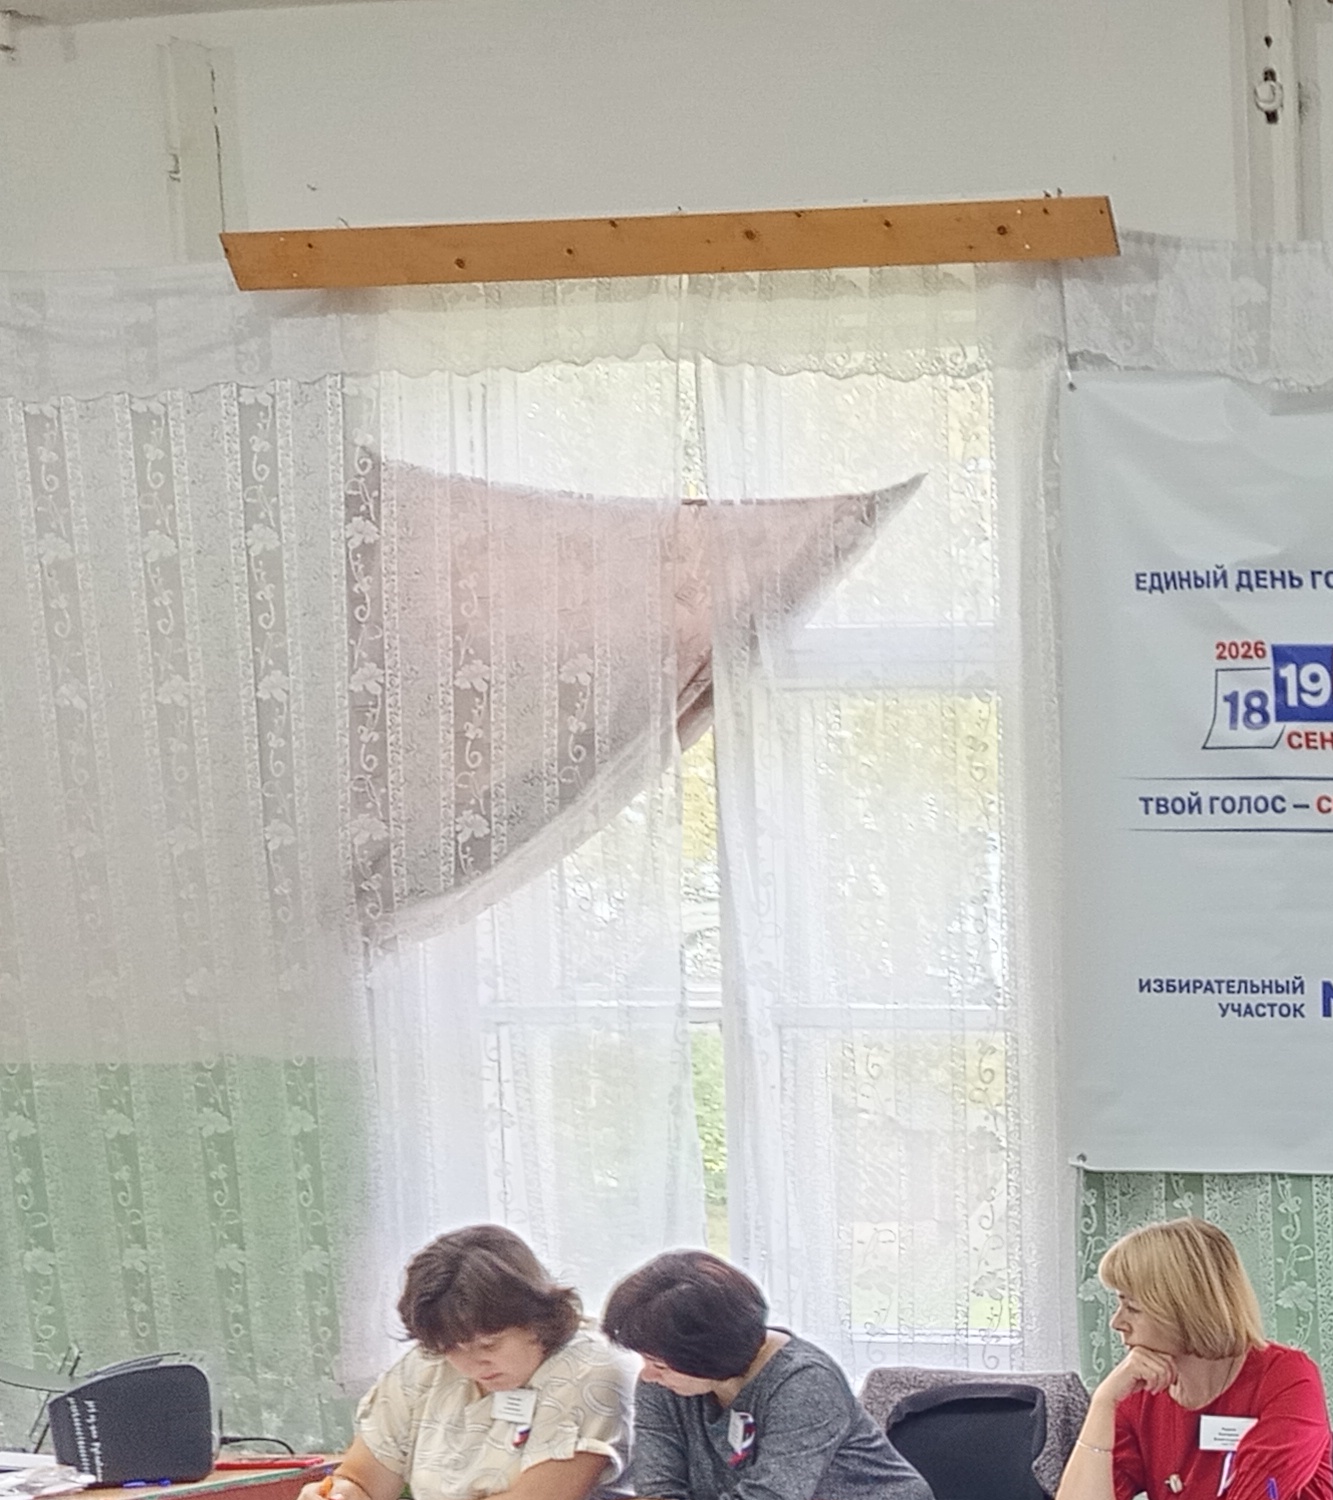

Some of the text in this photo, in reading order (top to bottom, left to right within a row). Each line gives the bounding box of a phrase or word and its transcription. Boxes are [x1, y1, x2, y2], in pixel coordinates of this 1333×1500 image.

[1134, 564, 1228, 594] ЕДИНЫЙ
[1235, 569, 1303, 594] ДЕНЬ
[1215, 640, 1267, 661] 2026
[1279, 663, 1333, 707] 19
[1223, 690, 1271, 731] 18
[1138, 791, 1203, 816] ТВОЙ
[1209, 795, 1287, 815] ГОЛОС
[1138, 976, 1305, 996] ИЗБИРАТЕЛЬНЫЙ
[1217, 1001, 1306, 1019] УЧАСТОК
